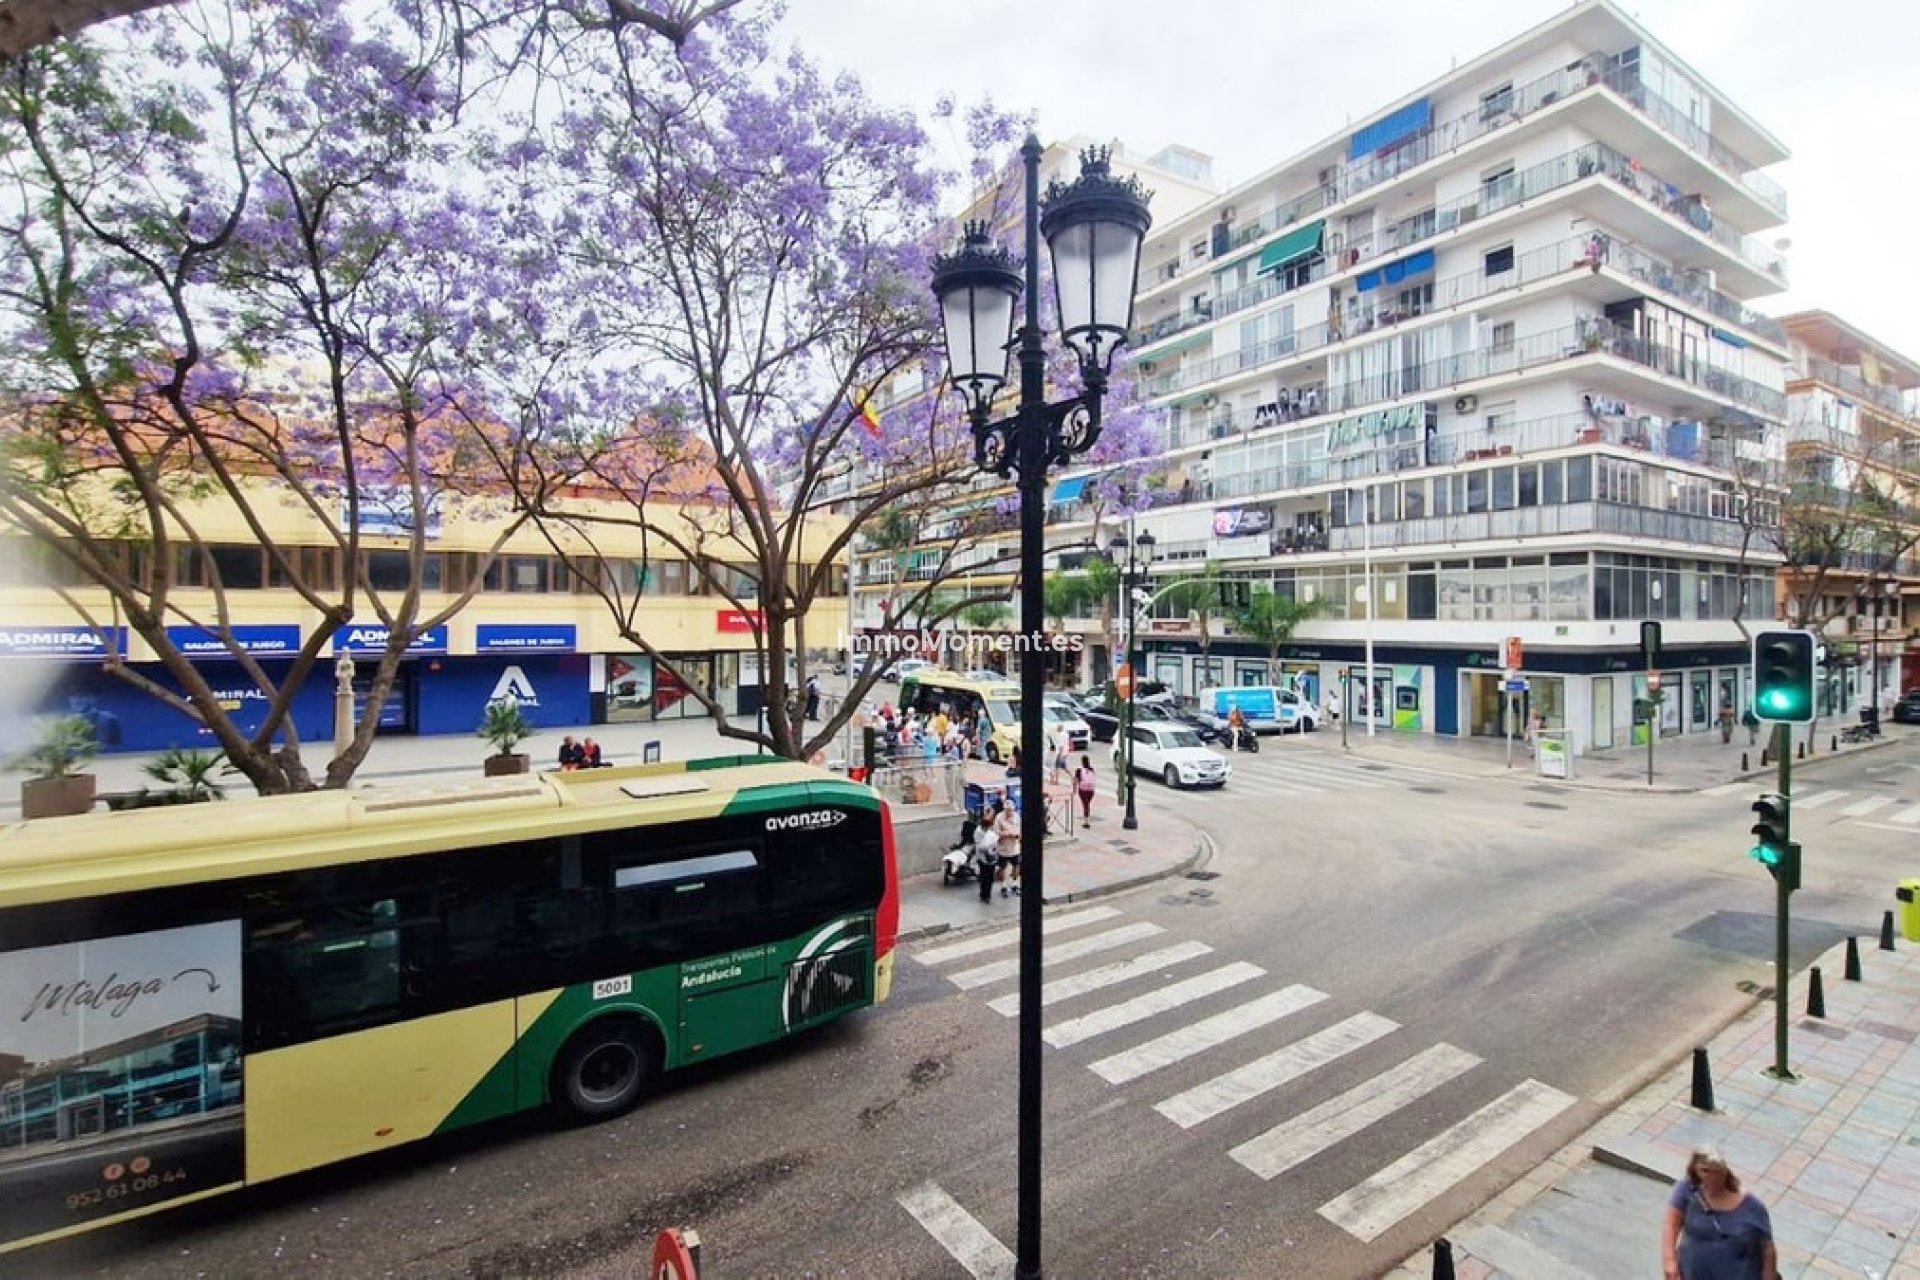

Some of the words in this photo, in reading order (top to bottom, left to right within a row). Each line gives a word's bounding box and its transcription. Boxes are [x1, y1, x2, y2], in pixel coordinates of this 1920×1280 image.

[347, 629, 435, 642] ADML
[765, 810, 831, 831] avanza
[596, 978, 629, 997] 5001
